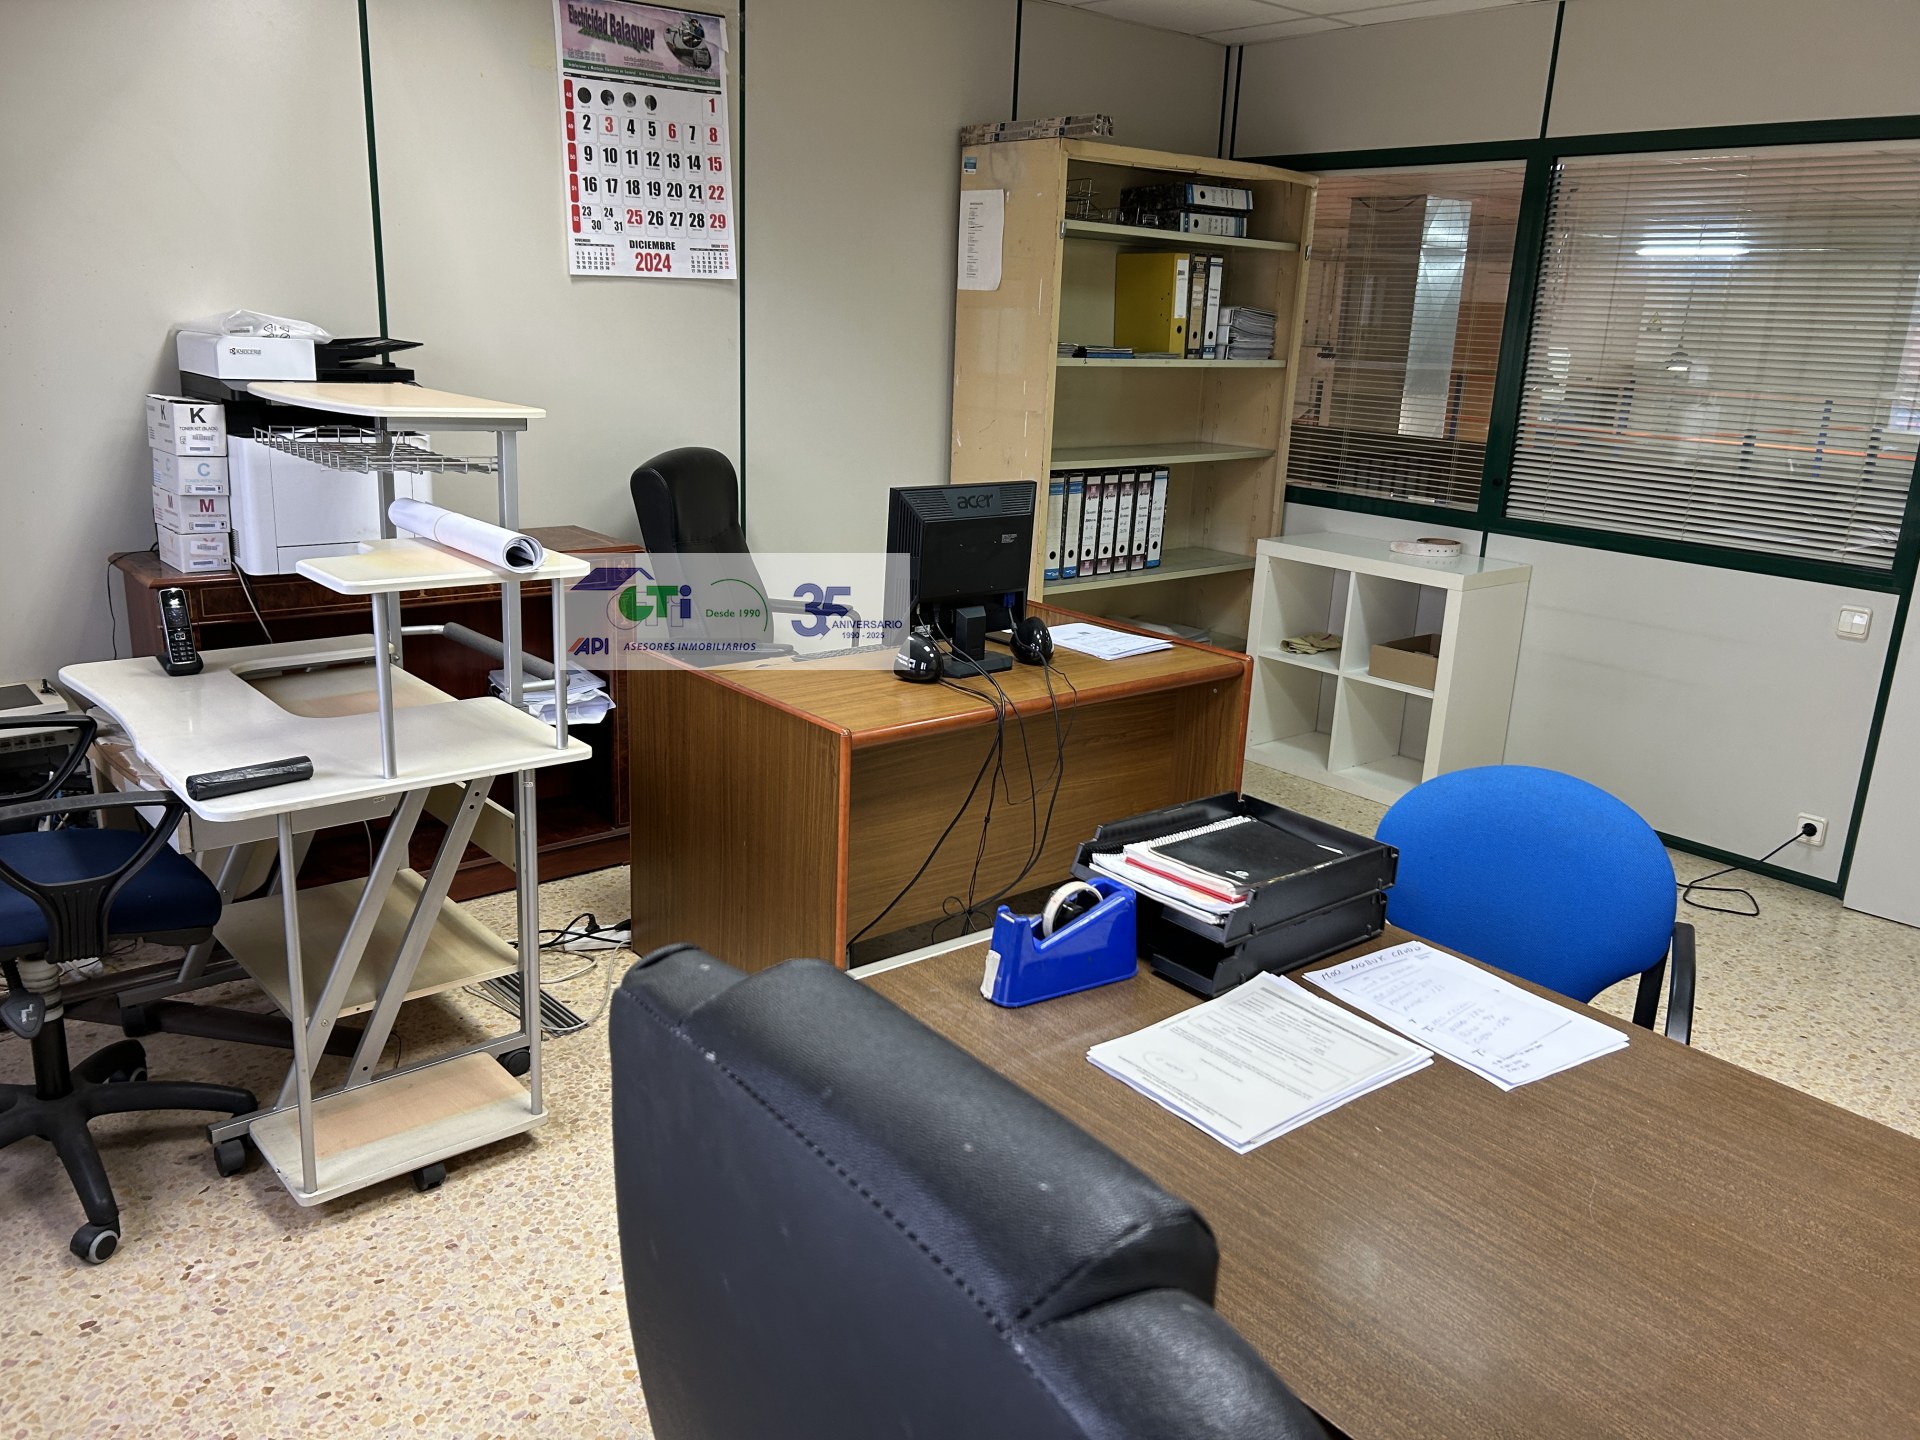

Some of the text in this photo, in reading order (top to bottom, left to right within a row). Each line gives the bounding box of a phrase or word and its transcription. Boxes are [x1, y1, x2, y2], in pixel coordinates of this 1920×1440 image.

[568, 4, 607, 35] Electricidad
[708, 98, 716, 113] 1
[583, 115, 591, 130] 2
[605, 117, 613, 132] 3
[627, 119, 635, 135] 4
[648, 121, 656, 136] 5
[668, 123, 676, 139] 6
[689, 126, 695, 140] 7
[709, 127, 718, 142] 8
[584, 146, 593, 161] 9
[603, 148, 618, 163] 10
[626, 149, 638, 165] 11
[646, 151, 660, 167] 12
[667, 154, 680, 169] 13
[687, 155, 701, 170] 14
[707, 157, 722, 172] 15
[582, 177, 598, 192] 16
[605, 178, 618, 193] 17
[626, 180, 640, 195] 18
[647, 182, 661, 196] 19
[667, 183, 682, 198] 20
[689, 184, 703, 199] 21
[708, 186, 725, 200] 22
[582, 206, 592, 216] 23
[604, 208, 614, 218] 24
[626, 209, 643, 224] 25
[647, 211, 664, 225] 26
[670, 212, 683, 227] 27
[689, 213, 705, 228] 28
[710, 214, 726, 229] 29
[591, 220, 623, 231] 30 31
[629, 240, 675, 251] DICIEMBRE
[635, 253, 671, 272] 2024
[161, 404, 166, 421] K
[190, 408, 206, 423] K
[197, 463, 210, 476] C
[200, 498, 215, 513] M
[957, 494, 993, 509] acer
